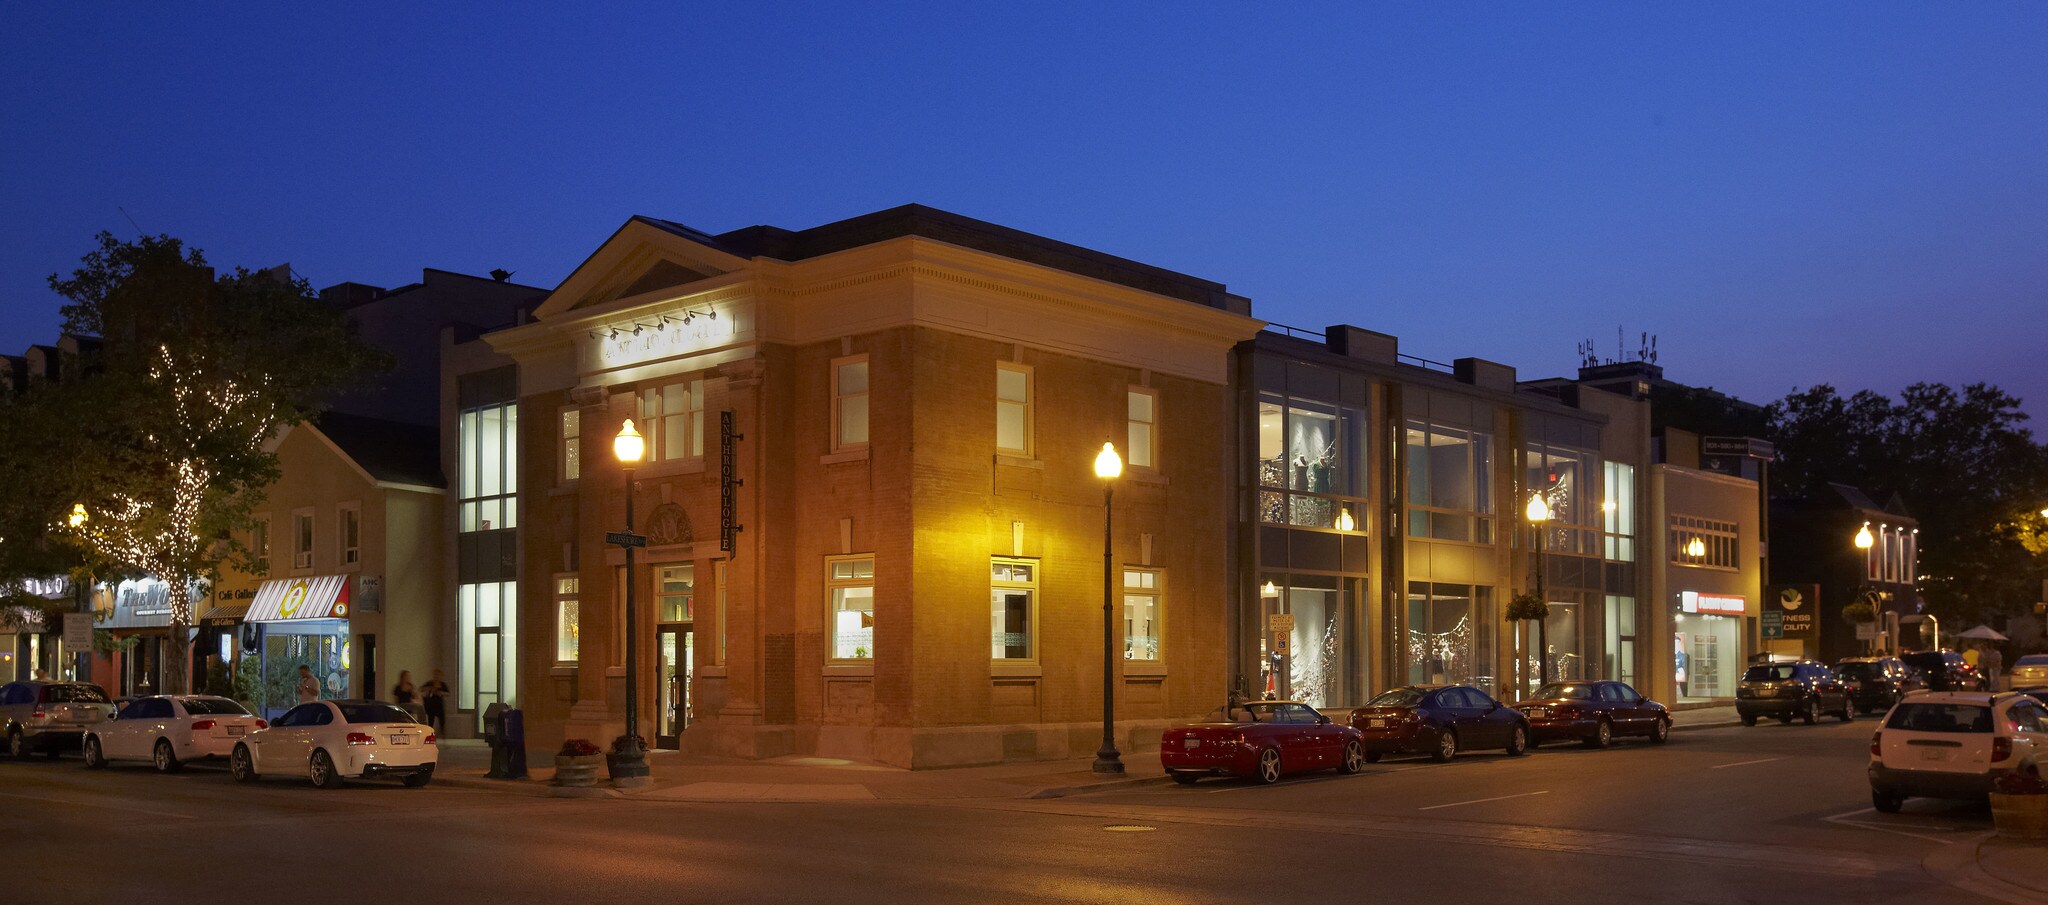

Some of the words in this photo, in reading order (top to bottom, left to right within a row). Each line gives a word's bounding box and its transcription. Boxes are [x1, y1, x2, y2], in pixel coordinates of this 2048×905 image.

[722, 414, 731, 549] ANTHROPOLOGIE
[25, 577, 63, 595] ELLO
[147, 583, 205, 606] WOKS
[235, 588, 258, 599] Galleri
[1782, 614, 1811, 622] TNESS
[1783, 623, 1811, 631] CILITY
